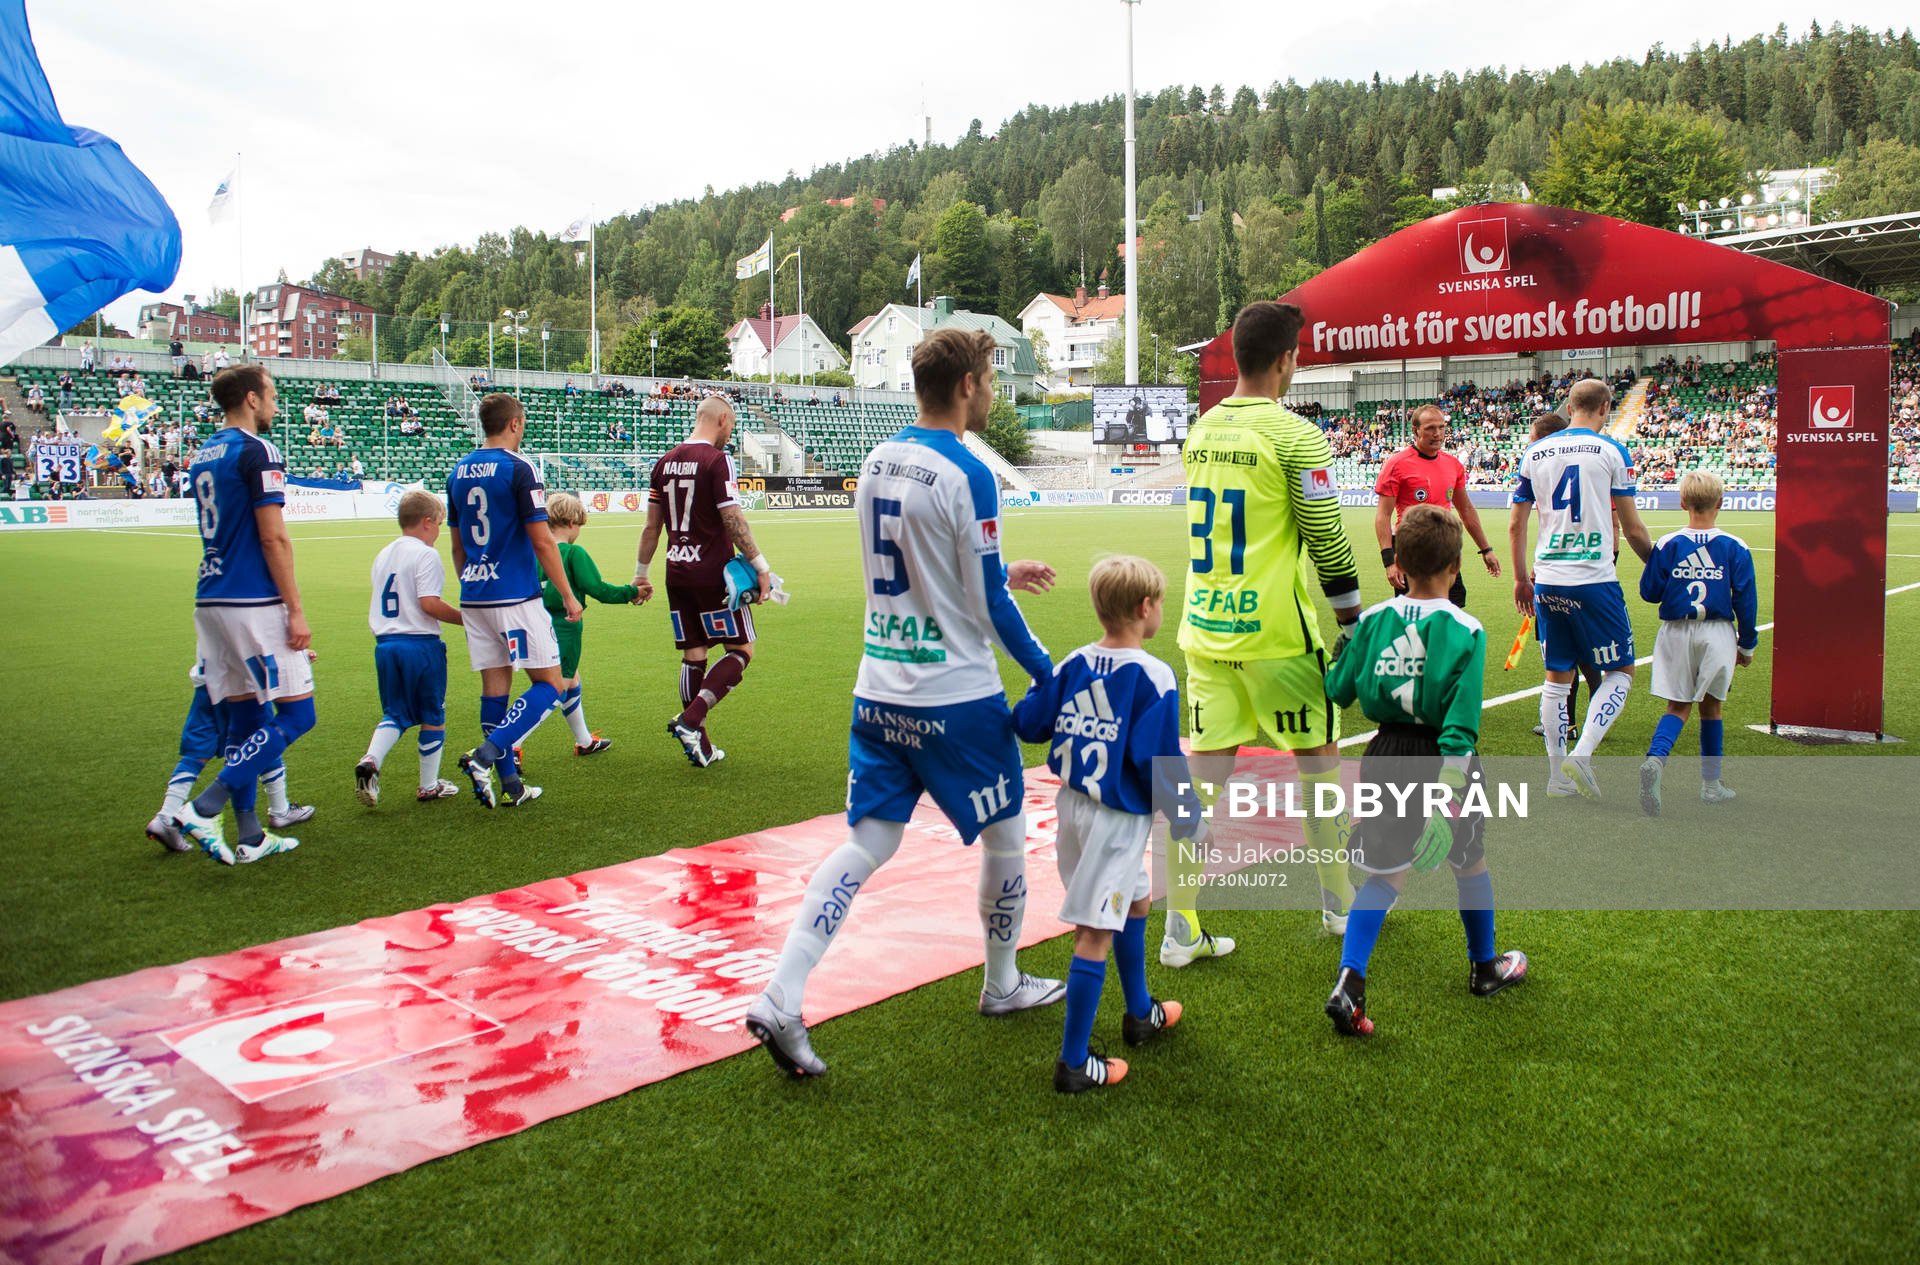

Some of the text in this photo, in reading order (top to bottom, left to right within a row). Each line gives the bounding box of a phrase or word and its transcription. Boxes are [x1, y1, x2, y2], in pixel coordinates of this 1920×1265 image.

[1438, 275, 1537, 294] SVENSKA SPEL
[1313, 291, 1702, 353] Framåt för svensk fotboll!
[38, 445, 78, 456] CLUB
[1787, 432, 1878, 443] SVENSKA SPEL
[41, 458, 78, 480] 33
[663, 461, 698, 476] NAURIN
[1532, 448, 1555, 461] axs
[457, 463, 498, 479] OLSSON
[196, 470, 219, 539] 8
[663, 479, 696, 531] 17
[793, 494, 850, 507] XL-BYGG
[1001, 494, 1031, 507] ordea
[1120, 490, 1173, 505] adidas
[1552, 463, 1581, 523] 4
[155, 505, 195, 515] norrland
[467, 486, 490, 546] 3
[1189, 486, 1247, 575] 31
[872, 497, 910, 597] 5
[1672, 565, 1723, 580] adidas
[381, 573, 399, 618] 6
[1686, 581, 1707, 621] 3
[857, 705, 946, 736] MÅNSSON
[1054, 712, 1118, 742] adidas
[1275, 703, 1312, 734] nt
[884, 728, 923, 750] RÖR
[1053, 737, 1109, 800] 13
[968, 773, 1012, 824] nt
[699, 948, 782, 985] fö
[27, 1014, 256, 1184] SVENSKA SPEL
